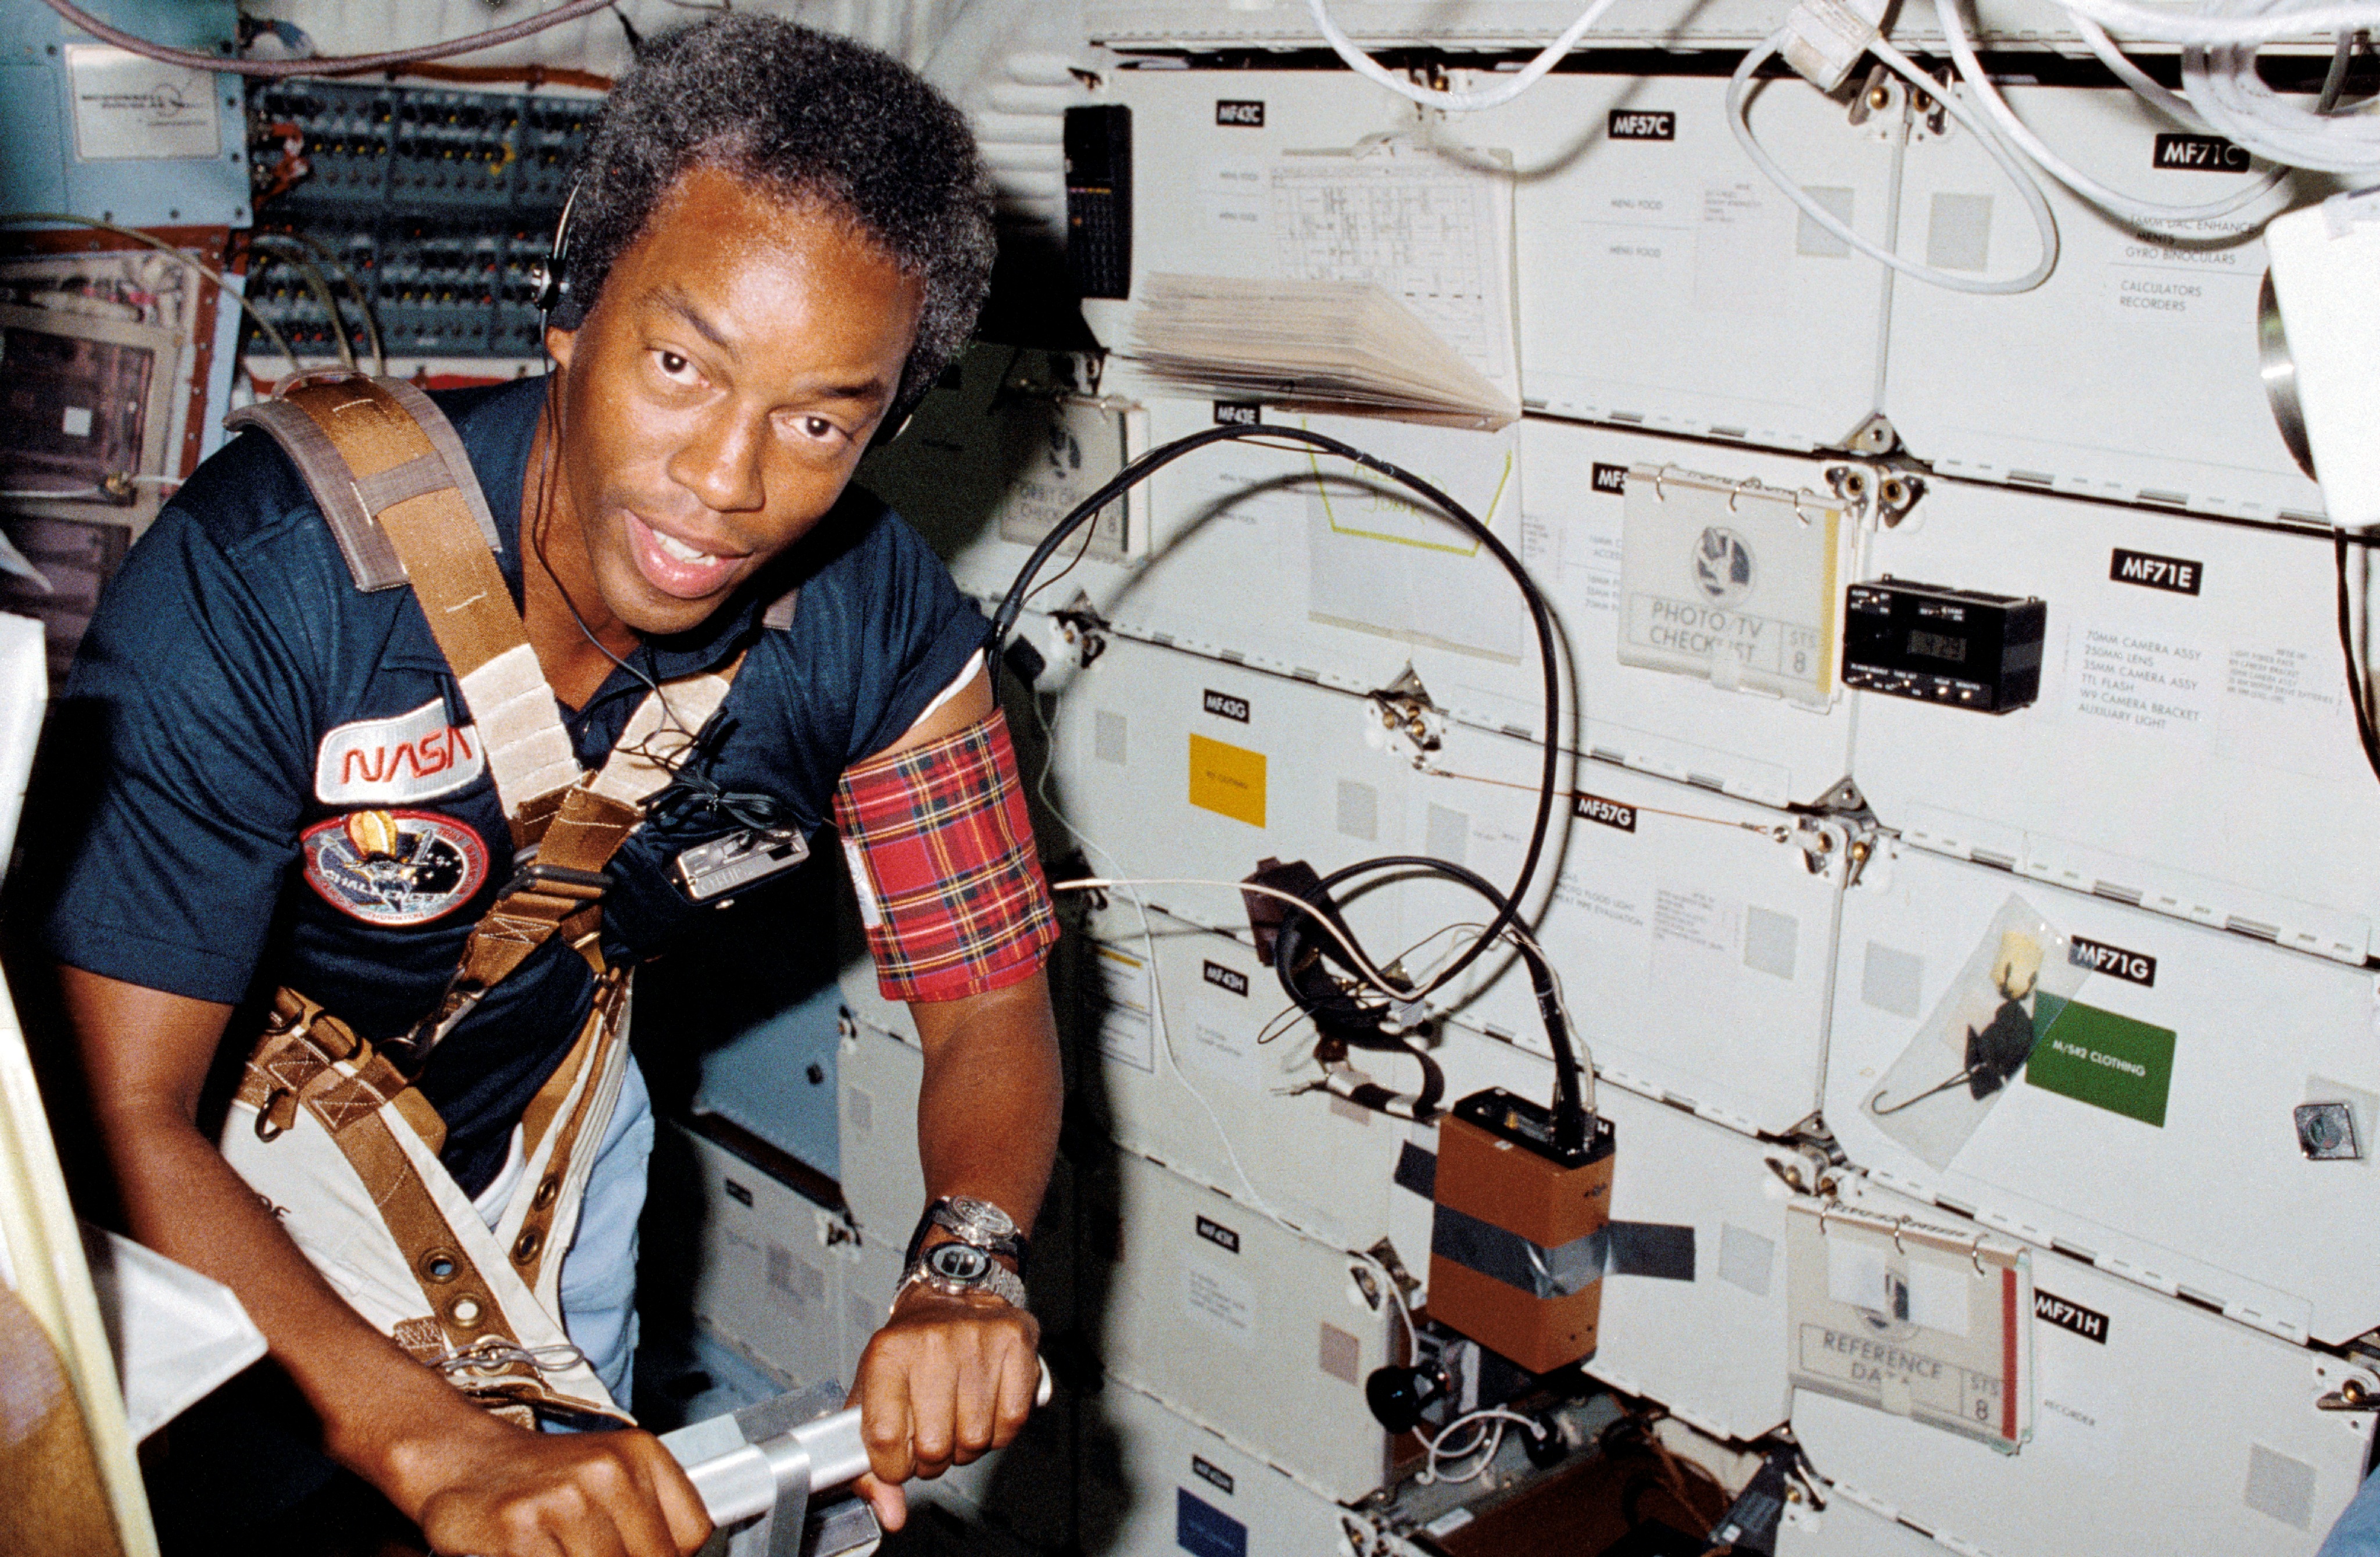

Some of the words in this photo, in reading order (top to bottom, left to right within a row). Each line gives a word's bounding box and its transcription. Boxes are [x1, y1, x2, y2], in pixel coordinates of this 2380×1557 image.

[1613, 116, 1669, 136] MF57C
[2163, 141, 2240, 166] MF71C
[1610, 199, 1635, 209] MENU
[1638, 199, 1663, 210] FOOD
[2167, 219, 2193, 231] DAC
[2135, 232, 2175, 245] MENTS
[1609, 245, 1634, 256] MENU
[1636, 246, 1662, 258] FOOD
[2125, 245, 2159, 259] GYRO
[2161, 248, 2236, 264] BINOCULARS
[2121, 279, 2202, 298] CALCULATORS
[2120, 295, 2186, 312] RECORDERS
[2122, 556, 2193, 588] MF71E
[1649, 625, 1755, 662] CHECKST
[1790, 629, 1817, 650] STS
[2087, 630, 2118, 644] 70MM
[2122, 636, 2169, 655] CAMERA
[2173, 647, 2202, 661] ASSY
[1794, 651, 1806, 673] 8
[2084, 643, 2123, 660] 250MM
[2127, 653, 2154, 667] LENS
[2082, 672, 2097, 685] TTL
[2102, 677, 2135, 692] FLASH
[2083, 658, 2116, 674] 35MM
[2119, 666, 2166, 685] CAMERA
[2170, 677, 2198, 690] ASSY
[1206, 694, 1247, 720] MF43G
[2078, 703, 2132, 722] AUXILIARY
[2135, 714, 2167, 729] LIGHT
[2080, 687, 2098, 699] W9
[2100, 692, 2147, 711] CAMERA
[2151, 702, 2200, 721] BRACKET
[340, 724, 473, 785] NASA
[1578, 798, 1631, 826] MF57G
[1584, 889, 1612, 905] FLOOD
[1594, 904, 1644, 927] EVALUATION
[2077, 942, 2149, 979] MF71G
[2090, 1050, 2146, 1078] CLOTHING
[2035, 1295, 2100, 1336] MF71H
[1823, 1329, 1943, 1379] REFERENCE
[1970, 1372, 2000, 1397] STS
[1975, 1398, 1989, 1421] 8
[2043, 1398, 2096, 1427] RECORDER
